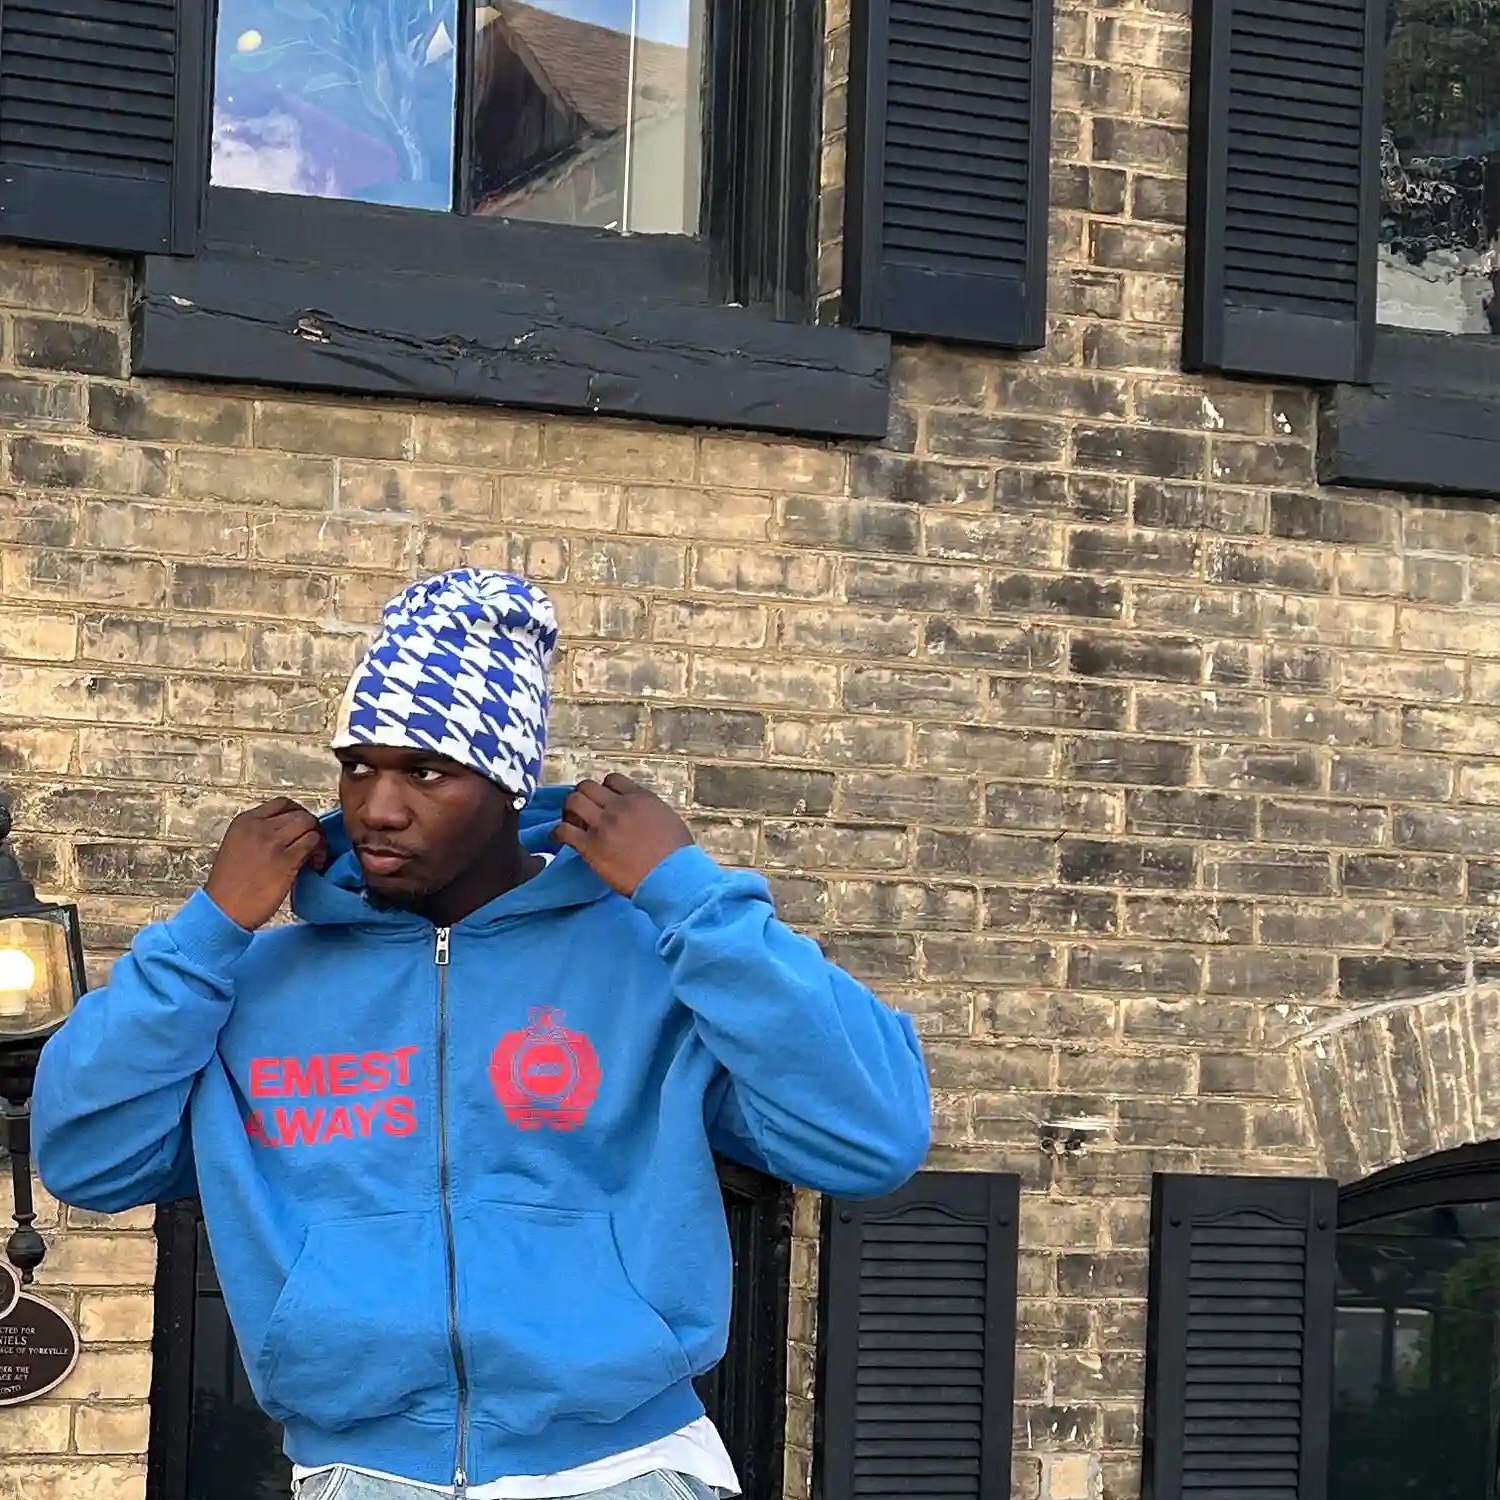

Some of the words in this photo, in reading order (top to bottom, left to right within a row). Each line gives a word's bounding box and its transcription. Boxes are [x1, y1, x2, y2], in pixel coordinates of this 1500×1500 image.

[249, 1045, 419, 1097] EMEST
[29, 1347, 69, 1355] YORKVILLE
[15, 1366, 30, 1374] THE
